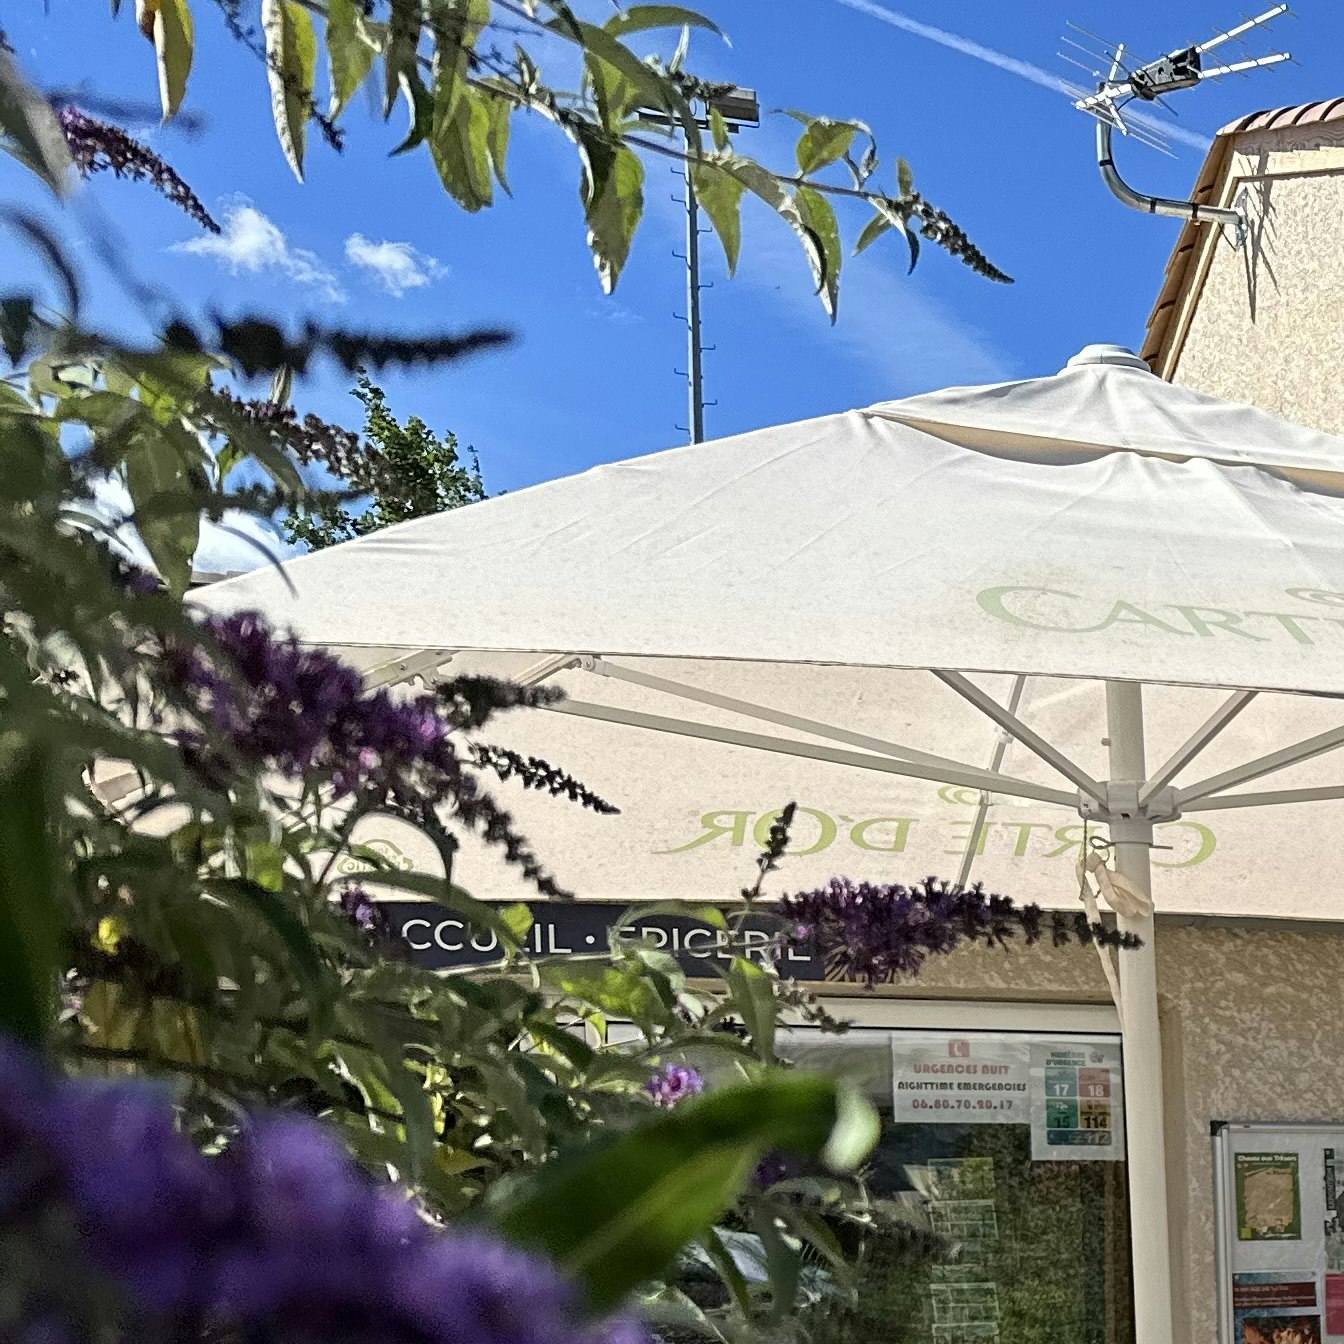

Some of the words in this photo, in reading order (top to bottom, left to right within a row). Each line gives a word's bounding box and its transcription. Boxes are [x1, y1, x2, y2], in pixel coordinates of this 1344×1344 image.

[401, 918, 573, 954] CCUIL
[913, 1063, 978, 1075] URGENCES
[981, 1064, 1010, 1075] NUIT
[897, 1081, 955, 1091] NIGHTTIME
[957, 1082, 1027, 1092] EMERGENCIES
[1054, 1084, 1070, 1096] 17
[1088, 1084, 1105, 1097] 18
[1083, 1115, 1108, 1129] 114
